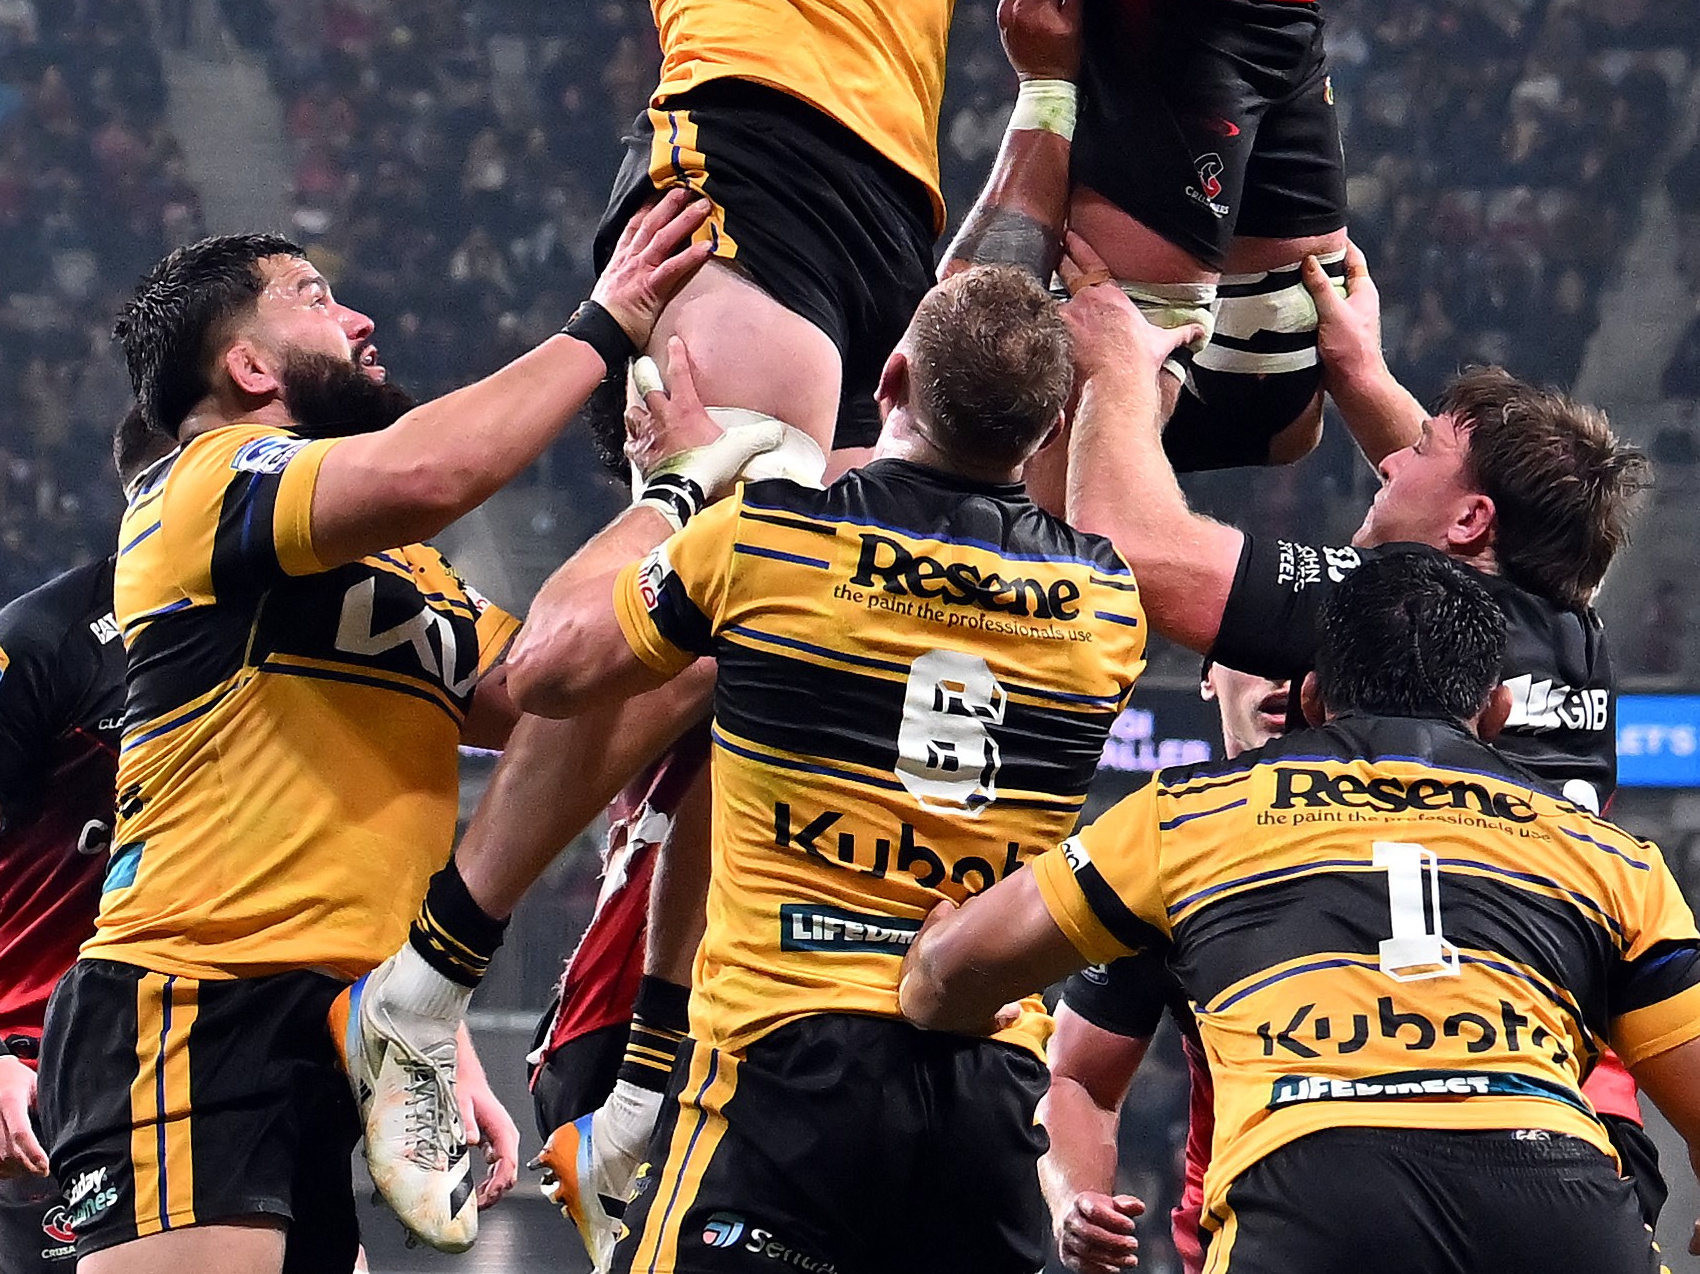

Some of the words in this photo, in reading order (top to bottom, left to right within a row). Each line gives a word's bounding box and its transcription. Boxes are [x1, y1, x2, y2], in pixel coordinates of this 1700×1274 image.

[850, 533, 1081, 621] Resene
[834, 584, 863, 604] the
[867, 594, 915, 618] paint
[917, 604, 945, 624] the
[949, 611, 1065, 643] professionals
[1067, 627, 1093, 644] use
[1557, 688, 1609, 731] GIB
[1257, 810, 1287, 826] the
[1293, 810, 1343, 826] paint
[1270, 767, 1538, 823] Resene
[774, 802, 1025, 900] Kubot
[1372, 841, 1460, 983] 1
[1257, 996, 1570, 1065] Kubota
[41, 1245, 77, 1260] CRUSA
